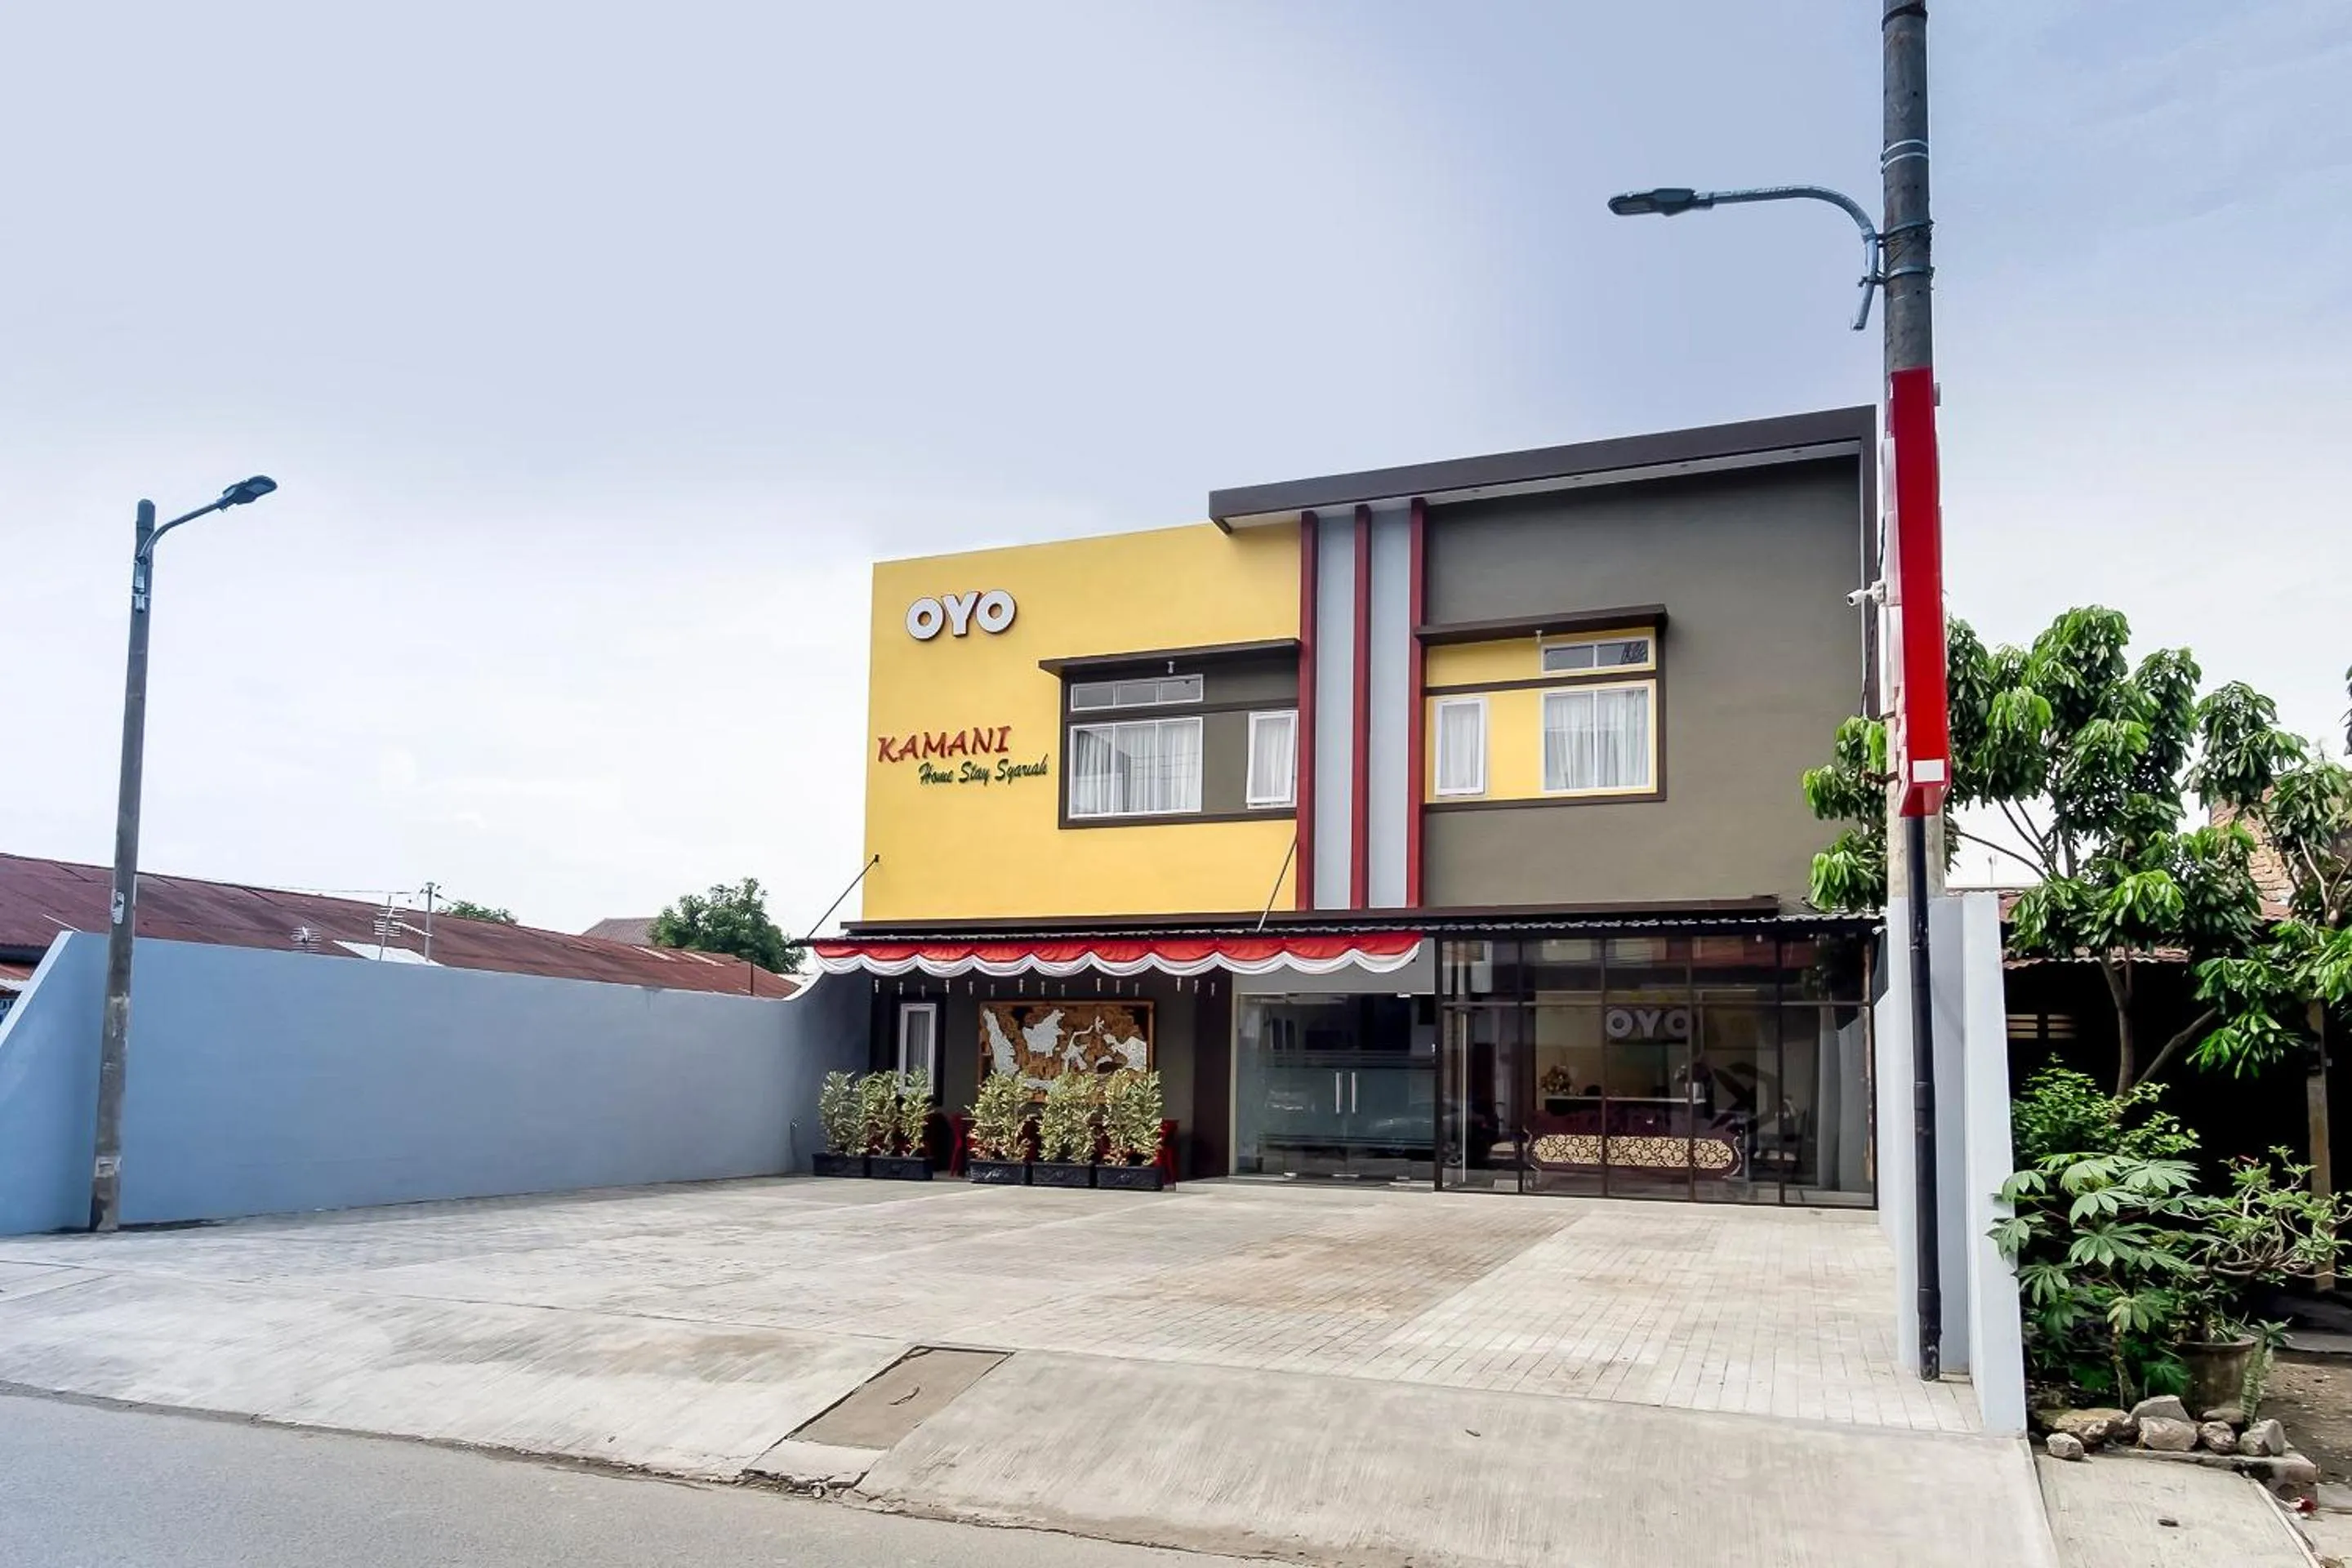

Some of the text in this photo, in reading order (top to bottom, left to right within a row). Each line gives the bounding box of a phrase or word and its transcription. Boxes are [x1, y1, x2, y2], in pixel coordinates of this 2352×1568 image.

[905, 589, 1017, 641] OYO
[878, 725, 1012, 763] KAMANI
[918, 761, 954, 785] Home
[958, 760, 990, 786] Stay
[1605, 1007, 1690, 1039] OYO
